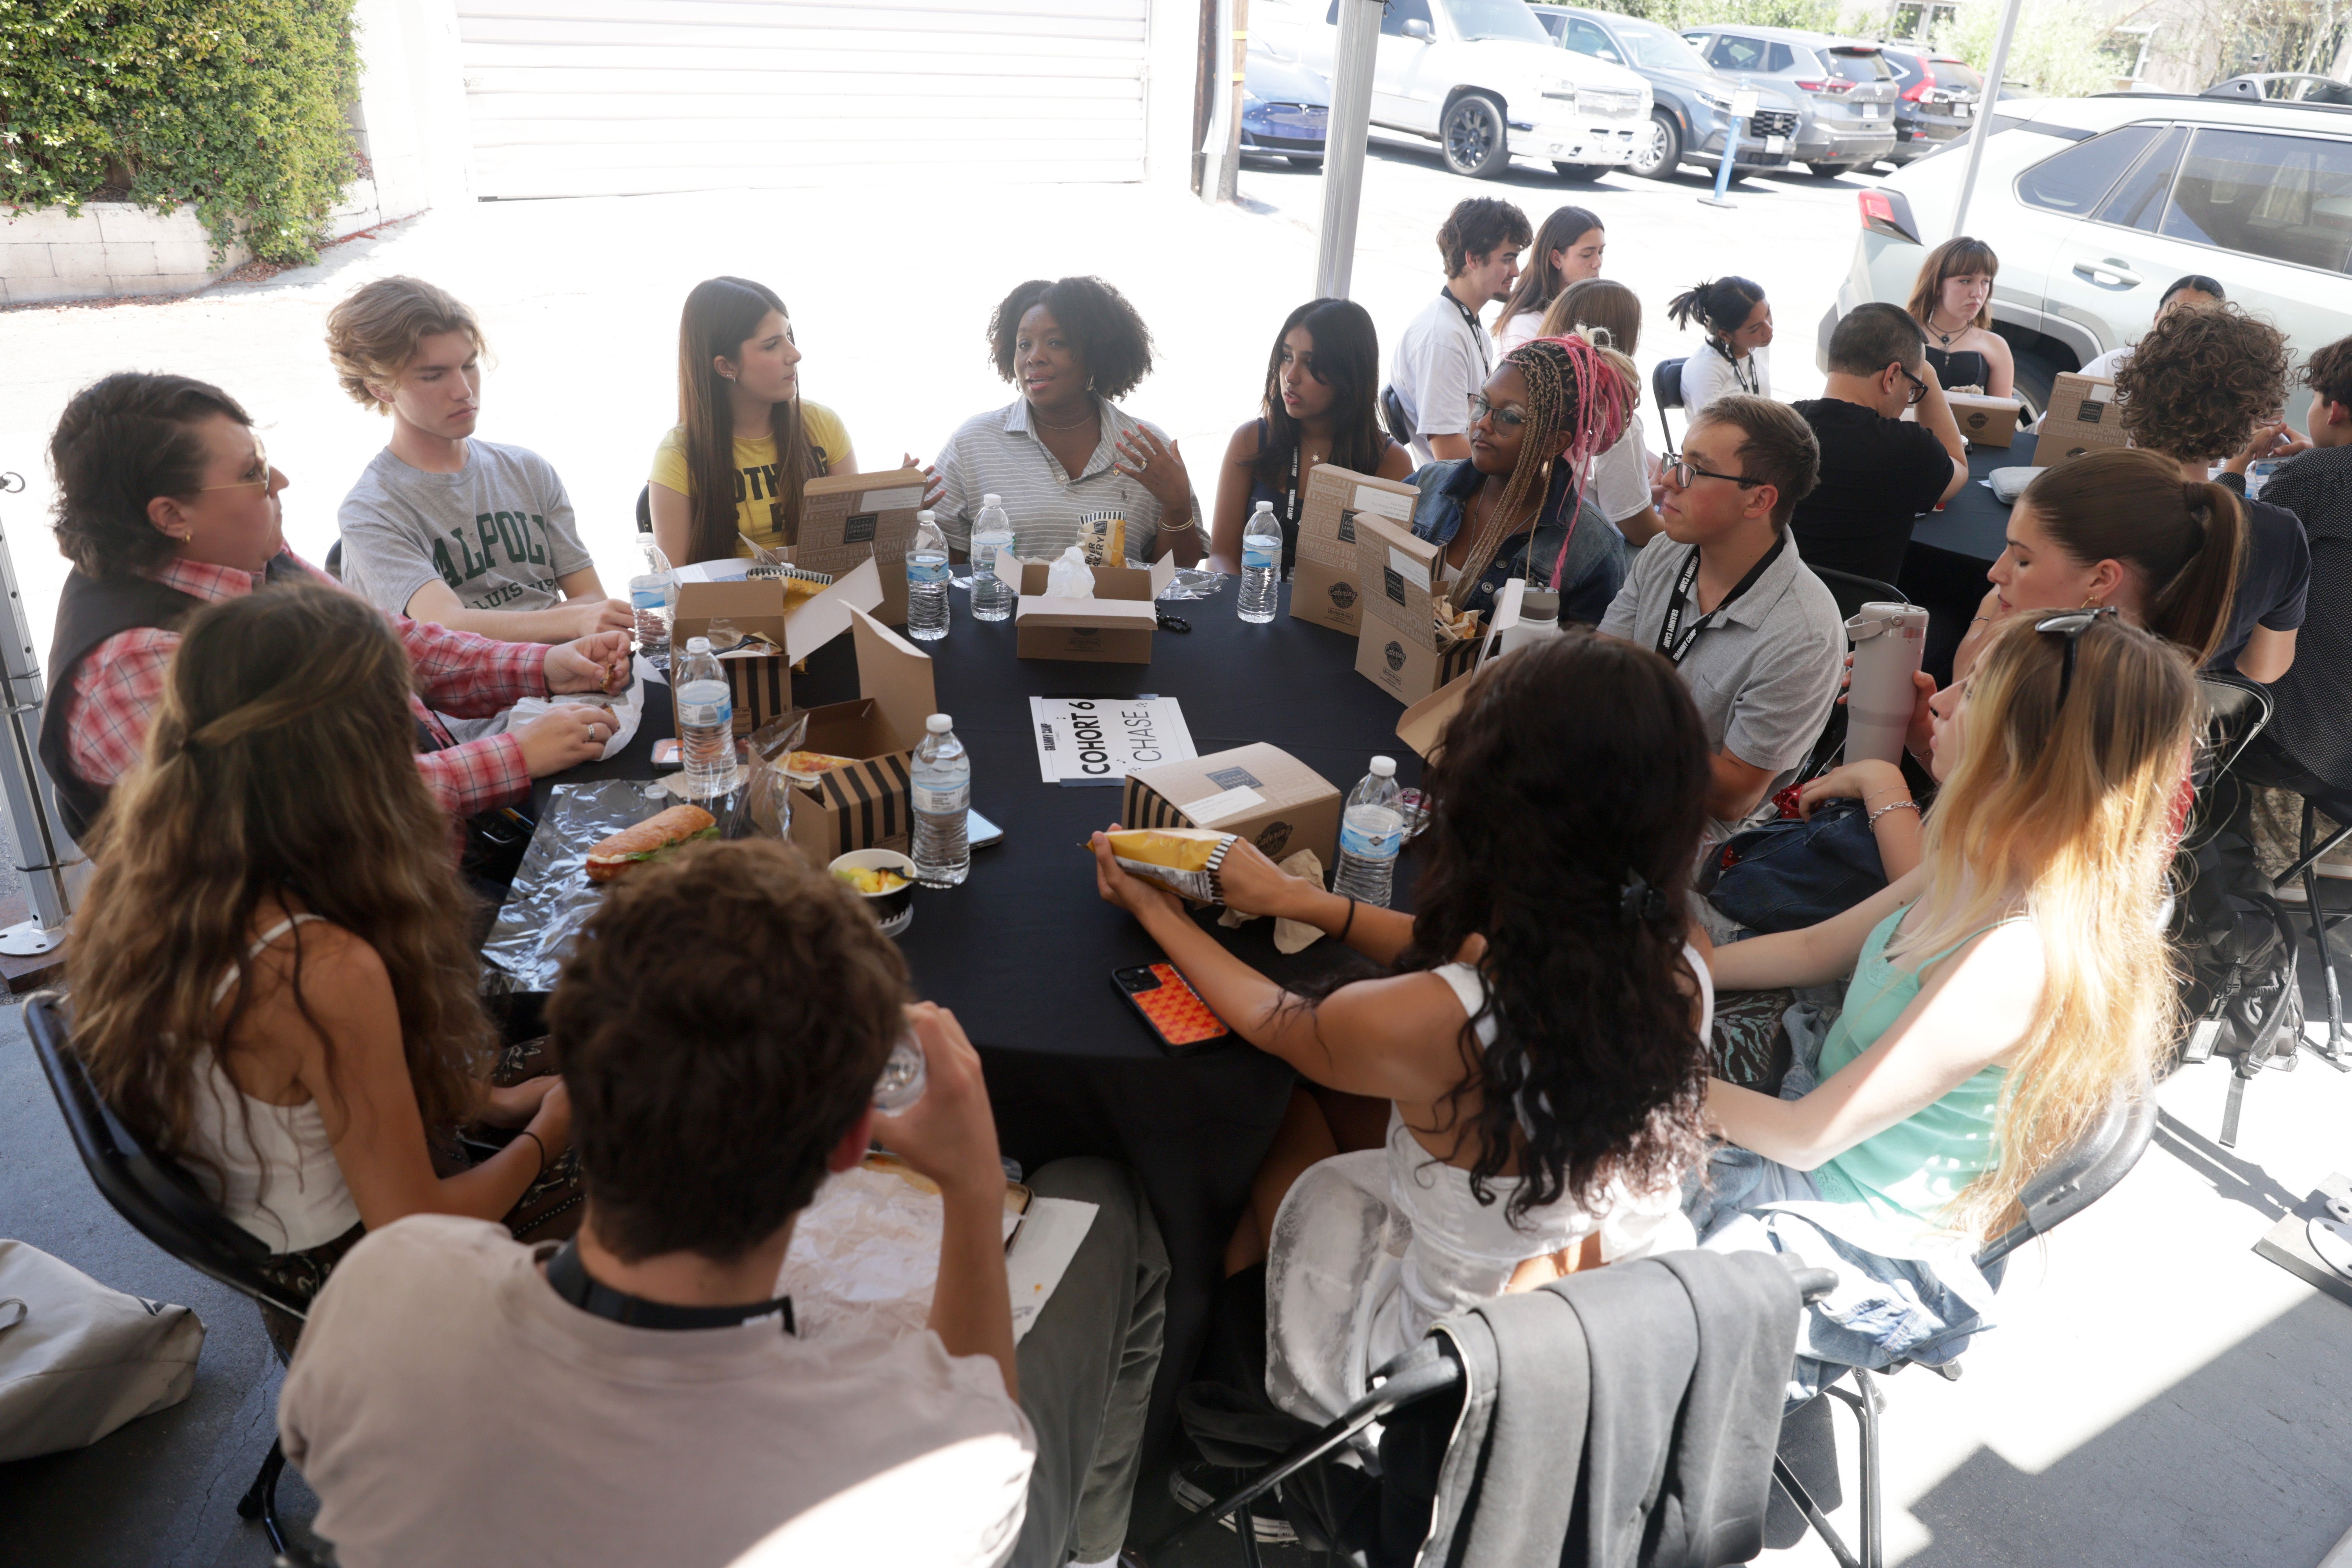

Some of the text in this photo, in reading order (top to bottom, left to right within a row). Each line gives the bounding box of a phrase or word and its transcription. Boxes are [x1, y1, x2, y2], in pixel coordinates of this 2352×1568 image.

[798, 551, 848, 564] PREPARED
[874, 539, 909, 553] UNCH
[1084, 542, 1096, 565] RNER
[1093, 536, 1105, 566] AKERY
[1298, 546, 1339, 565] FRESHLY
[1299, 538, 1357, 560] ADE PREPARED
[1678, 555, 1699, 594] GRAMMY CAMP
[473, 582, 523, 610] LUIS
[1328, 586, 1356, 601] Catering
[1392, 617, 1434, 650] CRAVEABLE
[1406, 612, 1434, 640] LUNCH
[1663, 609, 1679, 649] GRAMMY CAMP
[1385, 644, 1406, 663] Catering
[1672, 628, 1697, 661] GRAMMY CAMP
[1041, 723, 1056, 751] GRAMMY CAMP
[1069, 701, 1111, 775] COHORT 6
[1121, 711, 1162, 762] CHASE
[1255, 826, 1291, 847] Catering
